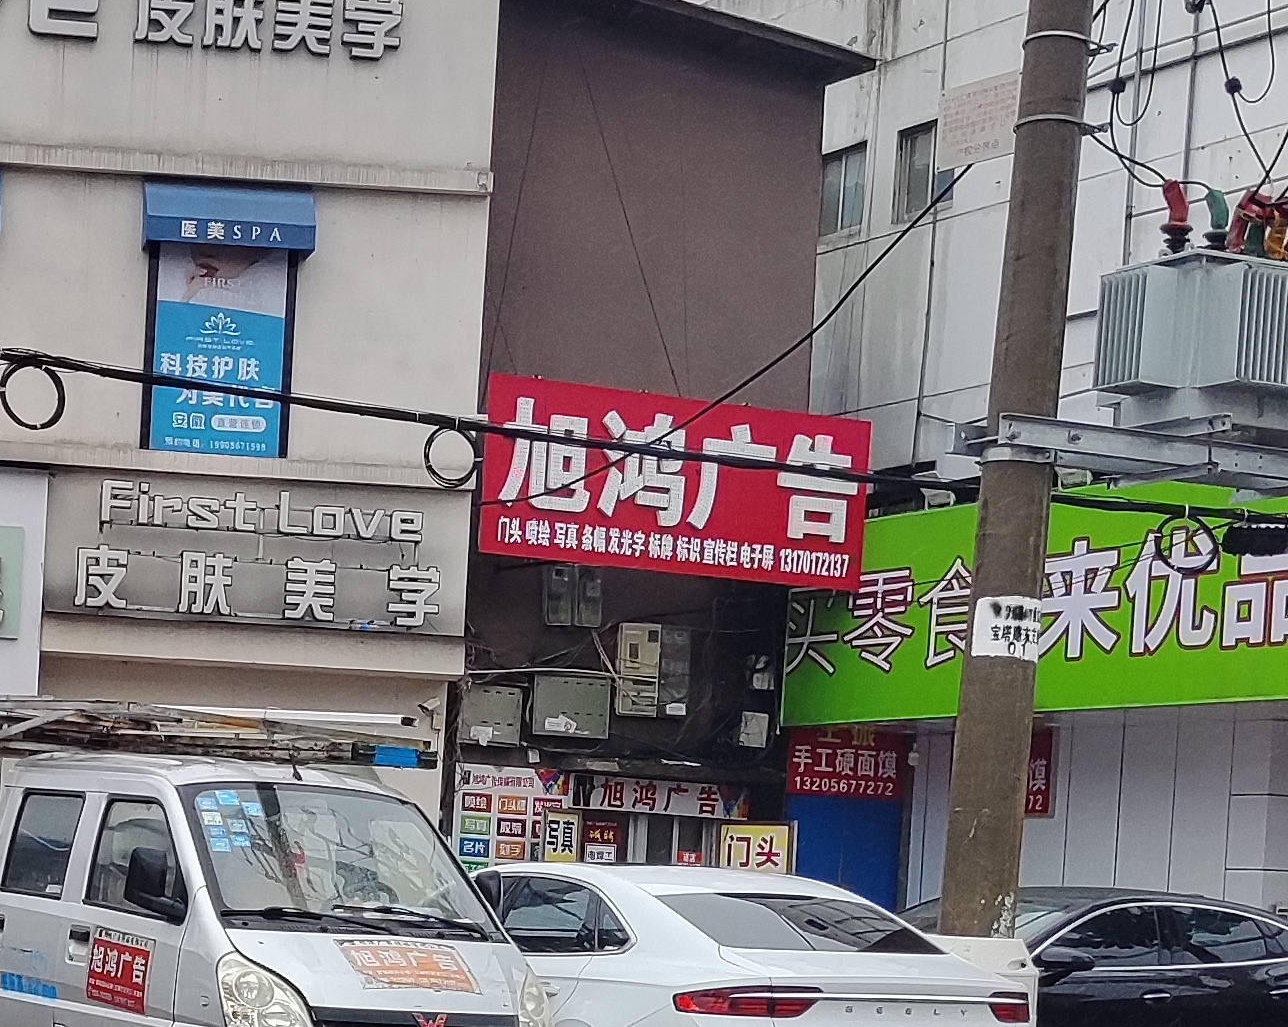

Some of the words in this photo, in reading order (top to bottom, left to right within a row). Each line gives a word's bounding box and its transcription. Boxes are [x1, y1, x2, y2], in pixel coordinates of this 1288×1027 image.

[159, 352, 260, 381] 科技护肤
[498, 397, 858, 544] 旭鸿广告
[497, 516, 522, 544] 门头
[525, 519, 550, 546] 喷绘
[554, 522, 579, 550] 写真
[581, 524, 606, 553] 条幅
[608, 527, 645, 558] 发光字
[648, 532, 674, 561] 标牌
[676, 535, 701, 563] 标识
[702, 538, 738, 567] 宣传栏
[740, 542, 775, 571] 电子屏
[779, 548, 850, 577] 13170172137
[73, 544, 441, 628] 皮肤美学
[1008, 642, 1026, 656] 01
[793, 745, 896, 779] 手工硬面馍
[600, 777, 719, 817] 旭鸿广告
[795, 776, 893, 795] 13205677272
[463, 840, 485, 853] 名片
[547, 819, 575, 854] 写真
[727, 835, 780, 868] 门头
[91, 944, 146, 985] 旭鸿广告
[350, 949, 459, 972] 旭鸿广告
[845, 1005, 968, 1017] GEELY
